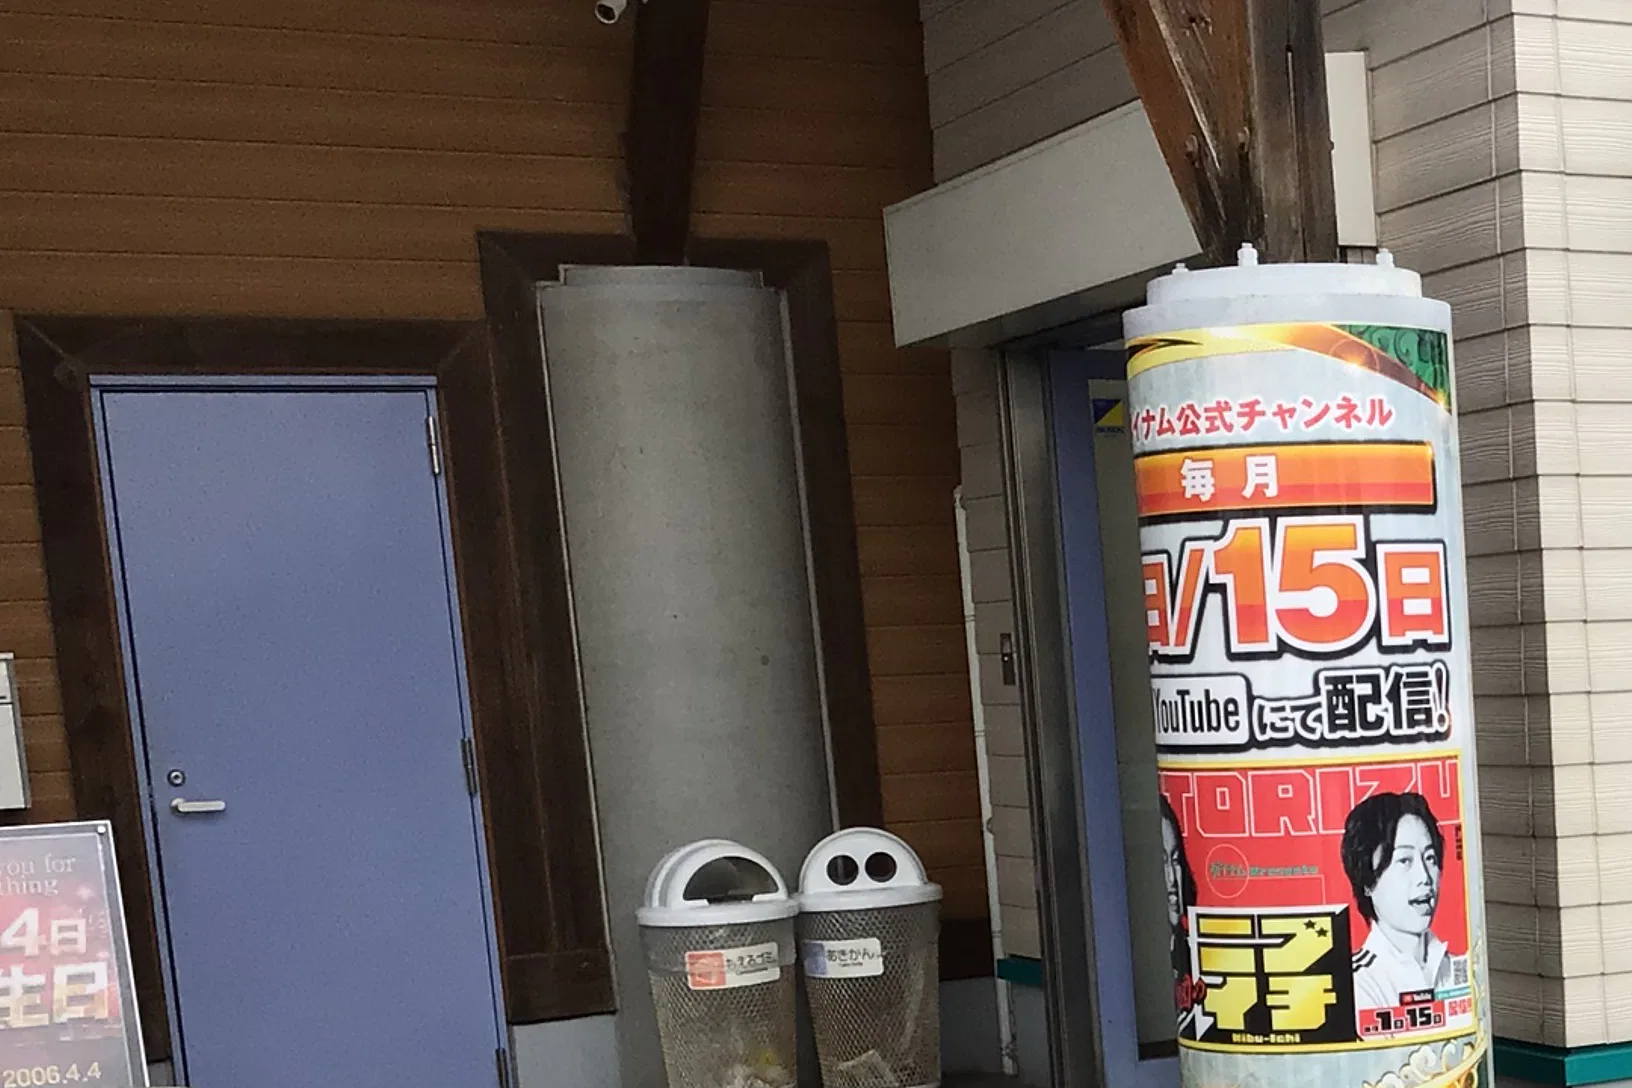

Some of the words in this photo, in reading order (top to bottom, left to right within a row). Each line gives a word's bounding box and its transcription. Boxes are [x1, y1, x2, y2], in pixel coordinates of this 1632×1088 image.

[1180, 455, 1279, 501] 毎月
[1153, 688, 1240, 733] YouTube
[0, 859, 35, 877] ou
[45, 853, 76, 874] for
[3, 1060, 102, 1088] 2006.4.4
